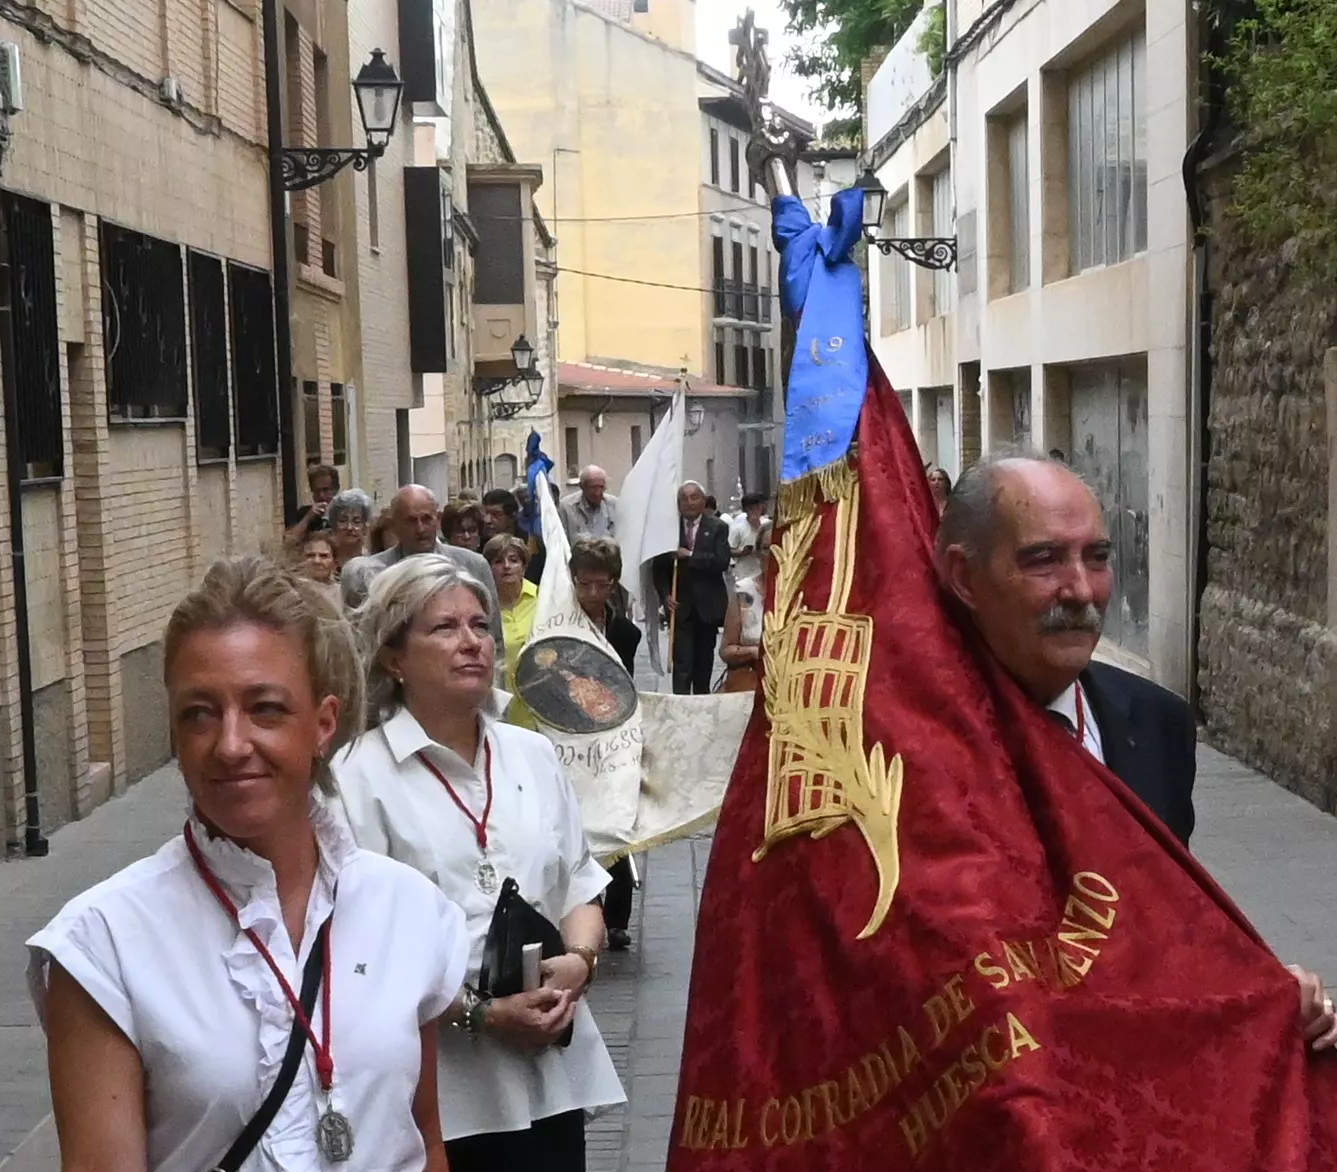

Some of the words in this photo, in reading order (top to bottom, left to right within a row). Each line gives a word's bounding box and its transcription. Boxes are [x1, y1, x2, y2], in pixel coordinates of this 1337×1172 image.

[679, 1095, 748, 1149] REAL
[760, 1026, 926, 1147] COFRADIA
[922, 974, 976, 1048] DE
[1051, 871, 1120, 988] ENZO
[899, 1012, 1041, 1158] HUESCA
